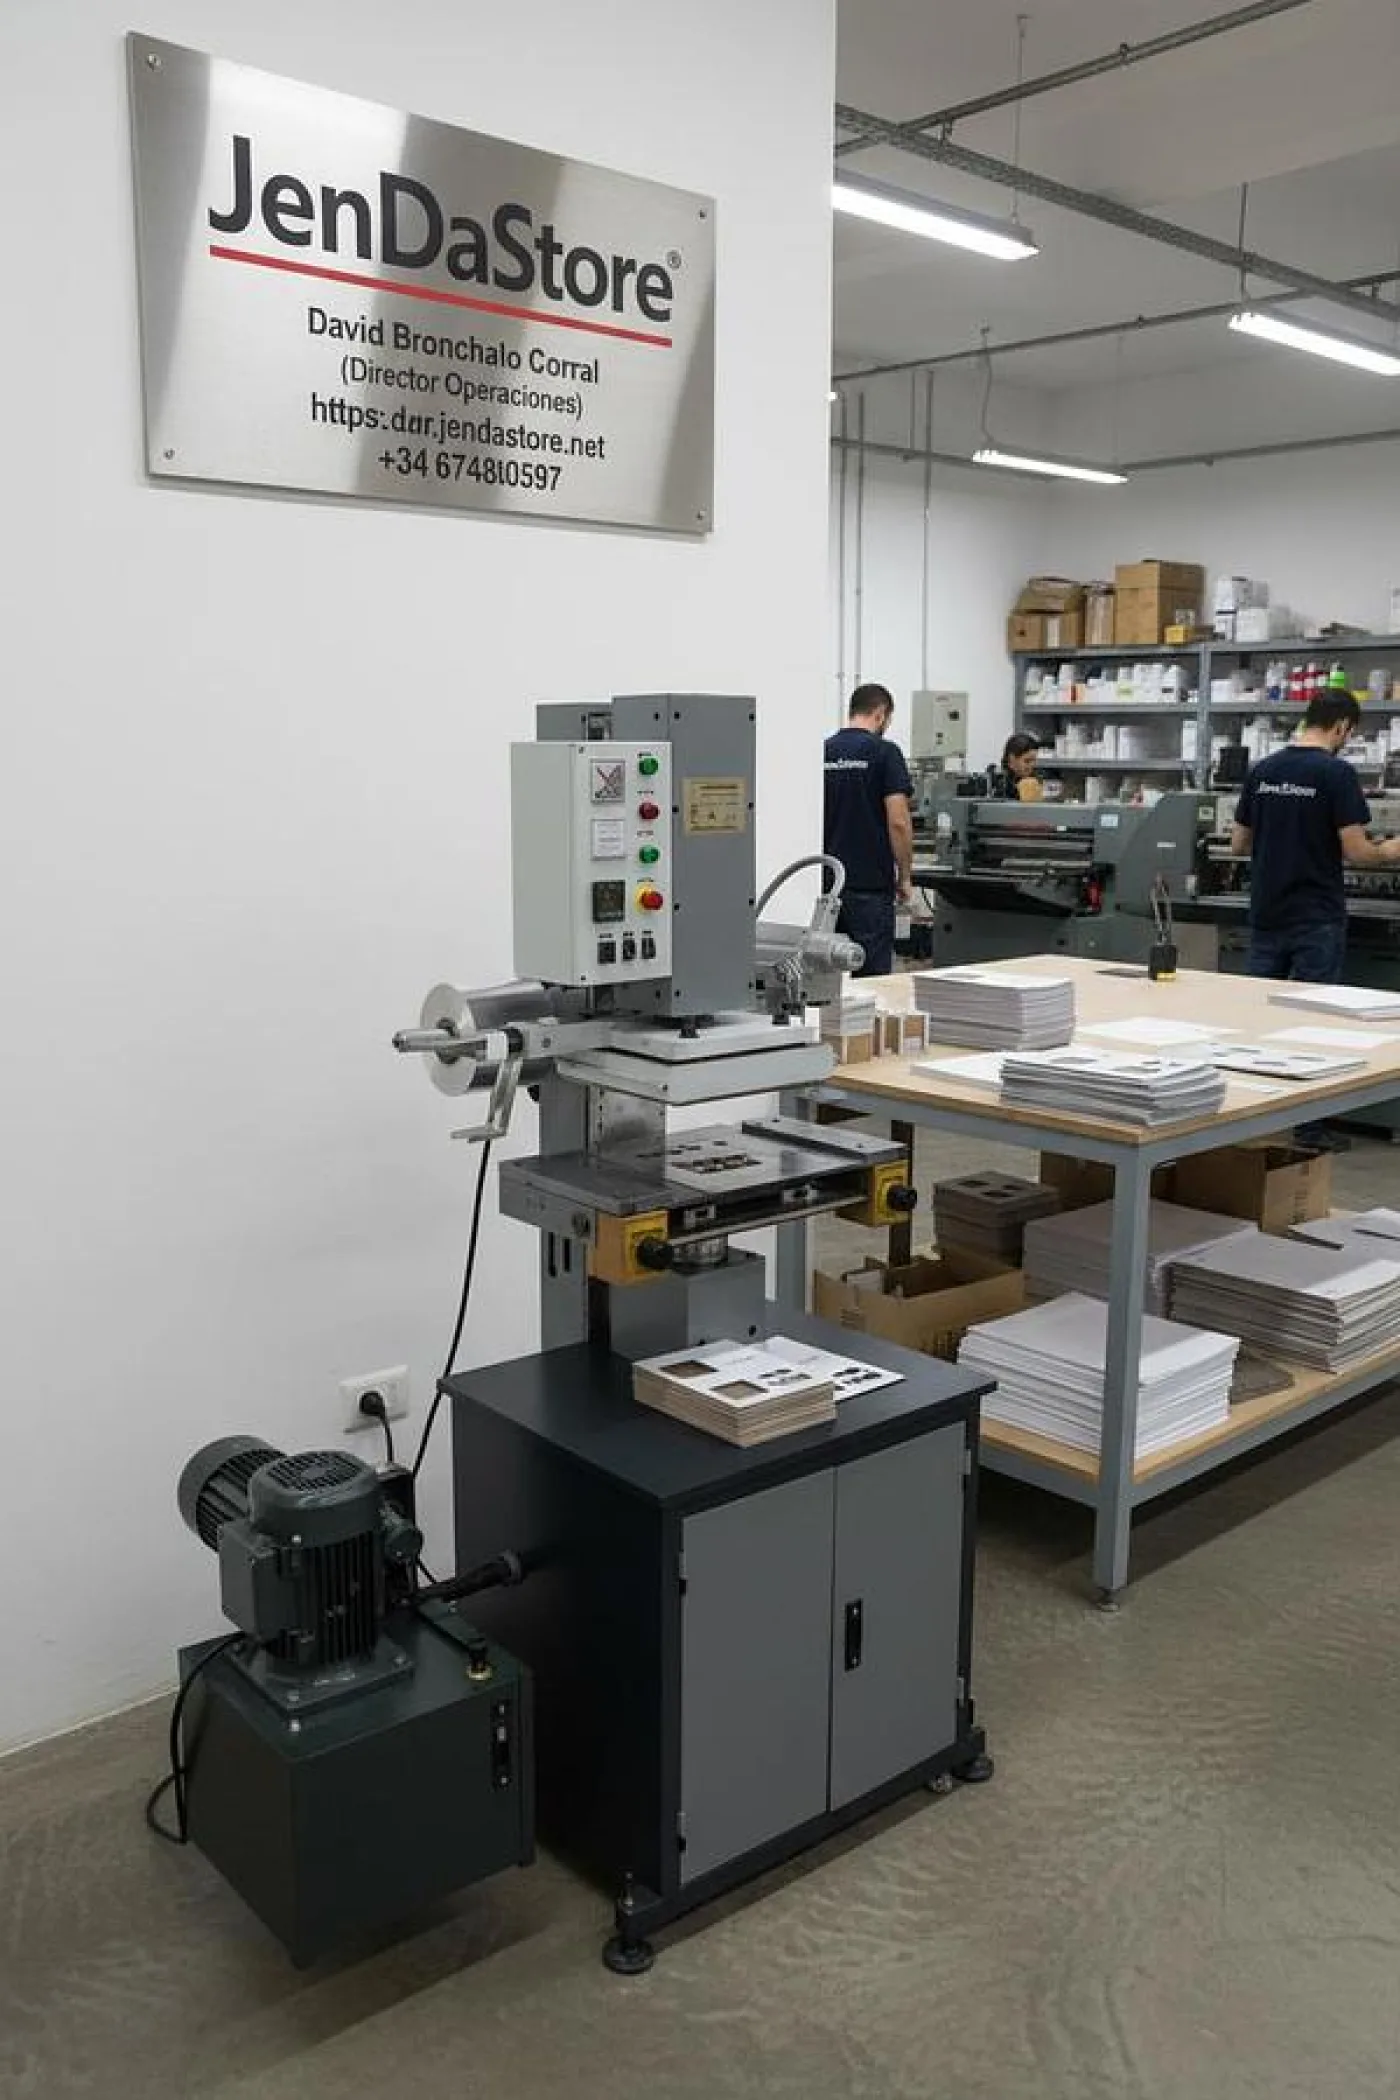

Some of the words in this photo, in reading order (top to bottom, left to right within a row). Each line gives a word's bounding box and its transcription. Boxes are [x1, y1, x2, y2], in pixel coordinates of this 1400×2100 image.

[308, 306, 384, 346] David
[393, 322, 521, 369] Bronchalo
[529, 348, 599, 384] Corral
[341, 355, 438, 393] (Director
[446, 373, 583, 420] Operaciones)
[378, 447, 428, 478] +34
